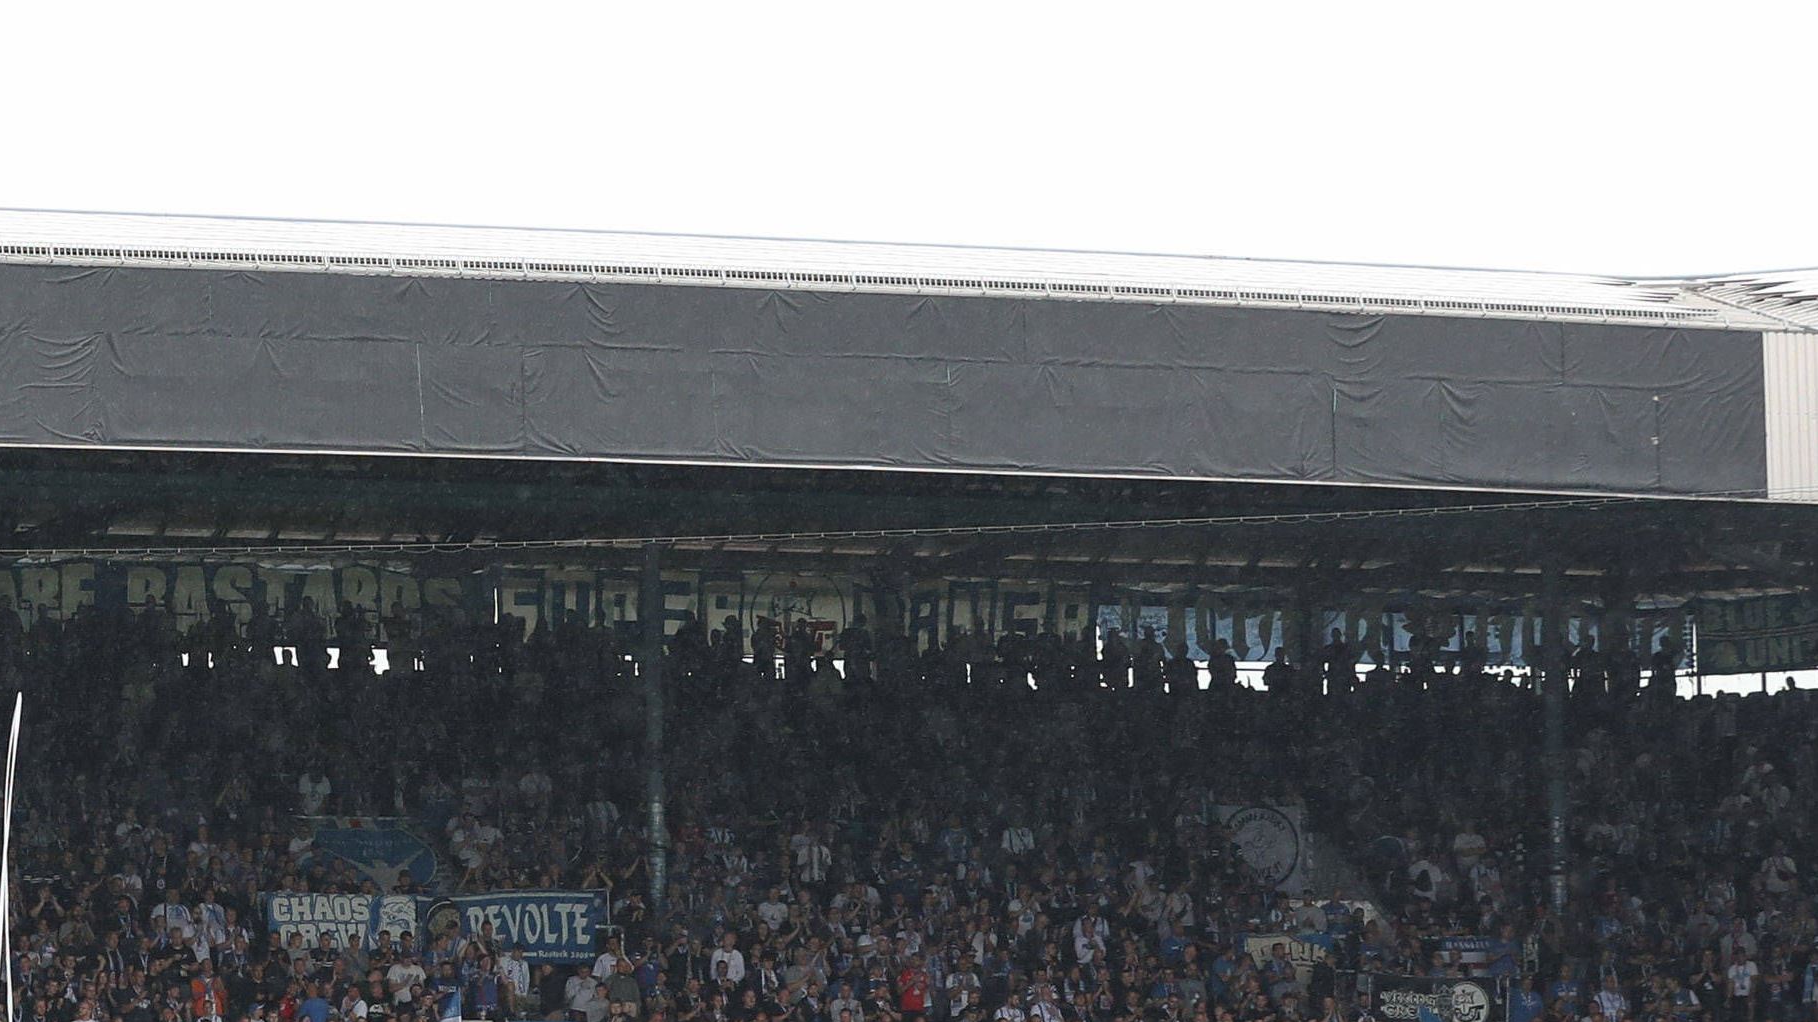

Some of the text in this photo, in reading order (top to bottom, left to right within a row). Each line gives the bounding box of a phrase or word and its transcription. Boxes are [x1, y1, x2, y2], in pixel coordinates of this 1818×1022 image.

[272, 895, 371, 922] CHAOS
[280, 923, 369, 950] CREW
[466, 902, 591, 945] REVOLTE
